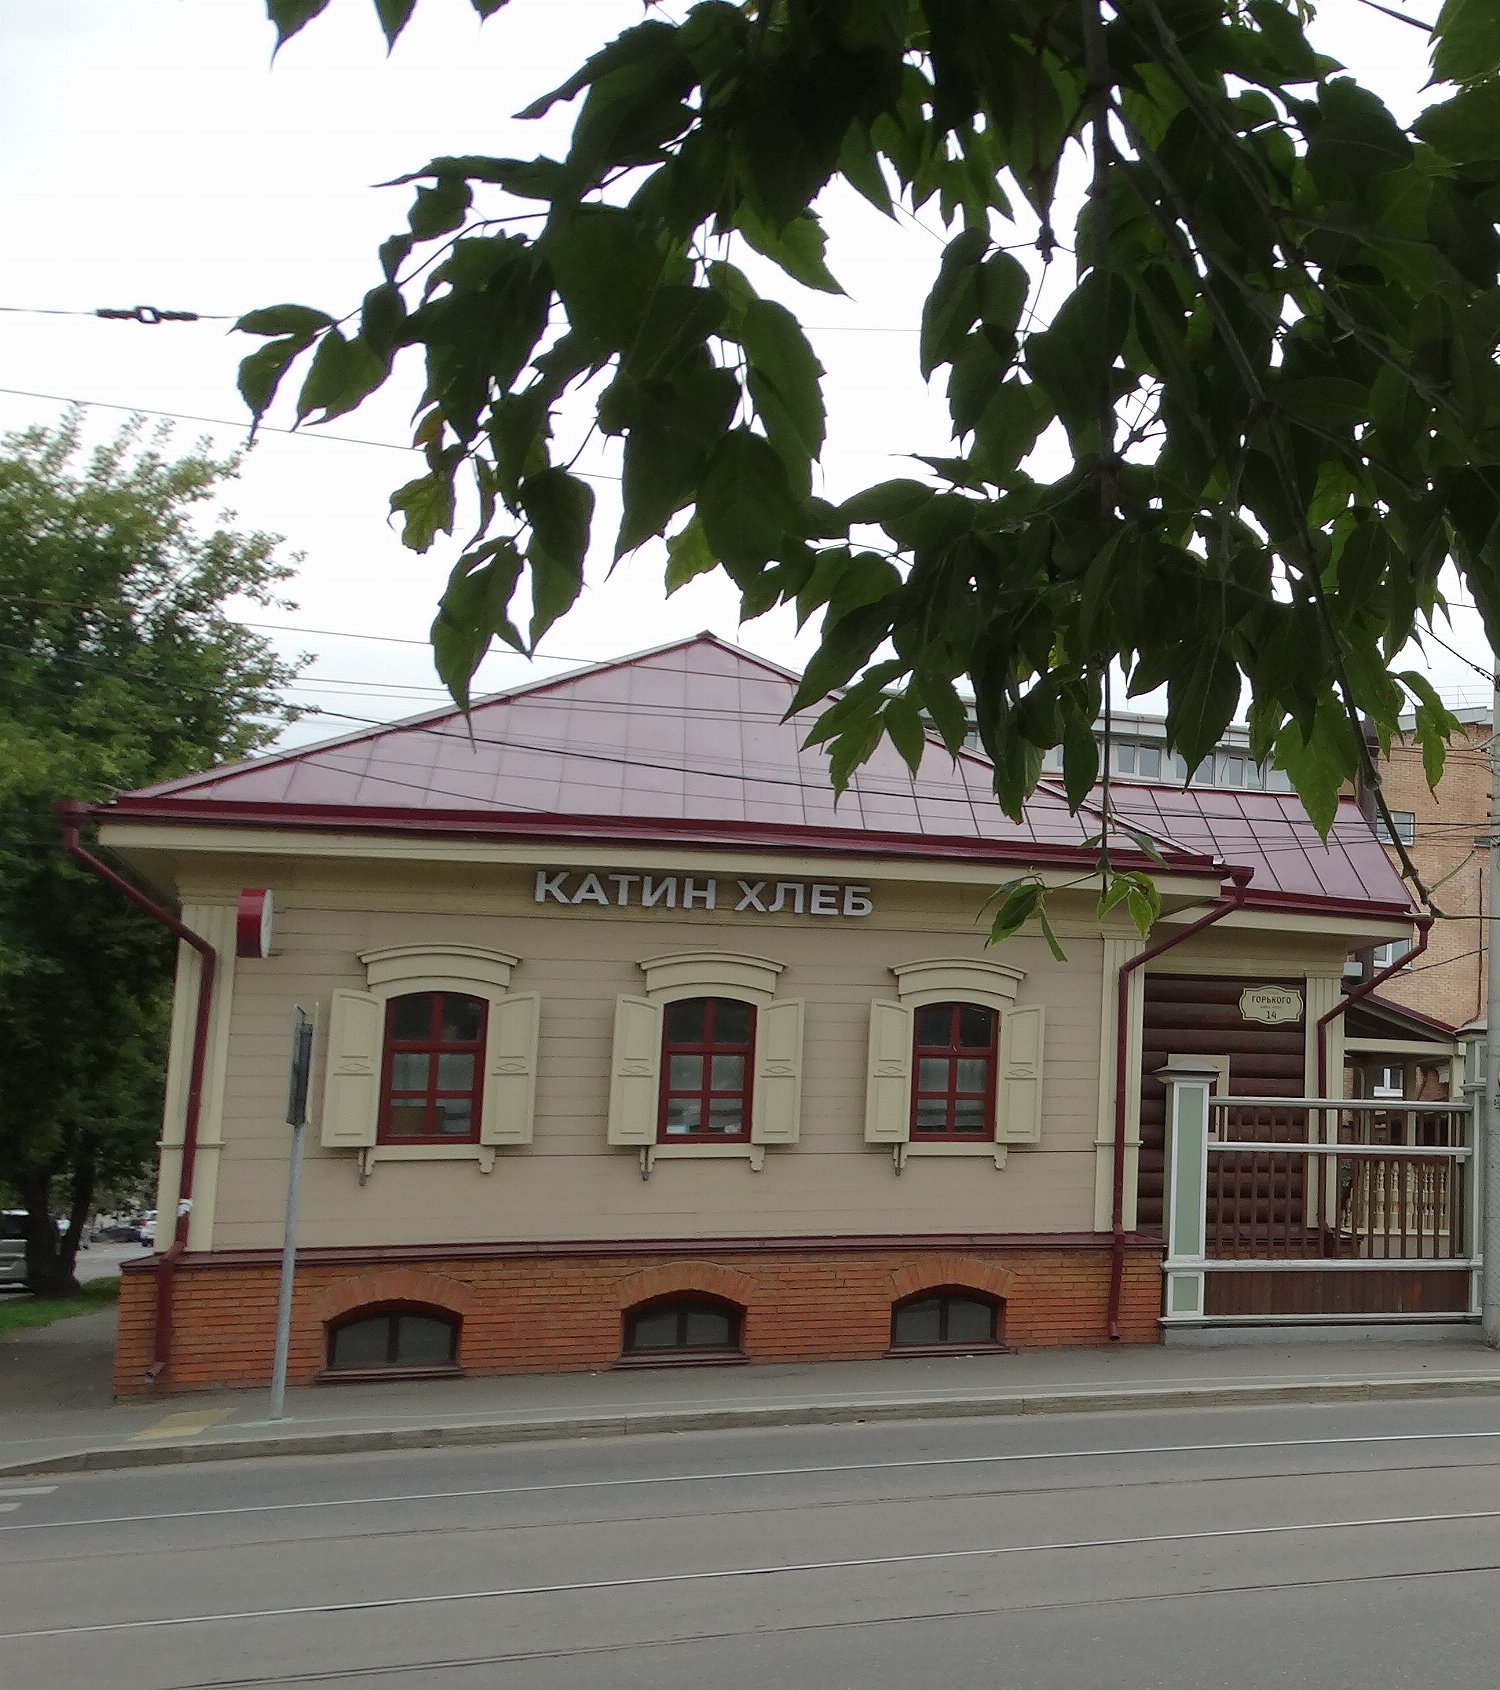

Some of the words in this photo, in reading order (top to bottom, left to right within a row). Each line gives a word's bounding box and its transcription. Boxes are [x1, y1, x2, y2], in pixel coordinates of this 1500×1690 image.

[534, 870, 717, 911] КАТИН
[733, 879, 874, 917] ХЛЕБ
[1251, 995, 1292, 1005] ГОРЬКОГО
[1266, 1010, 1277, 1020] 14
